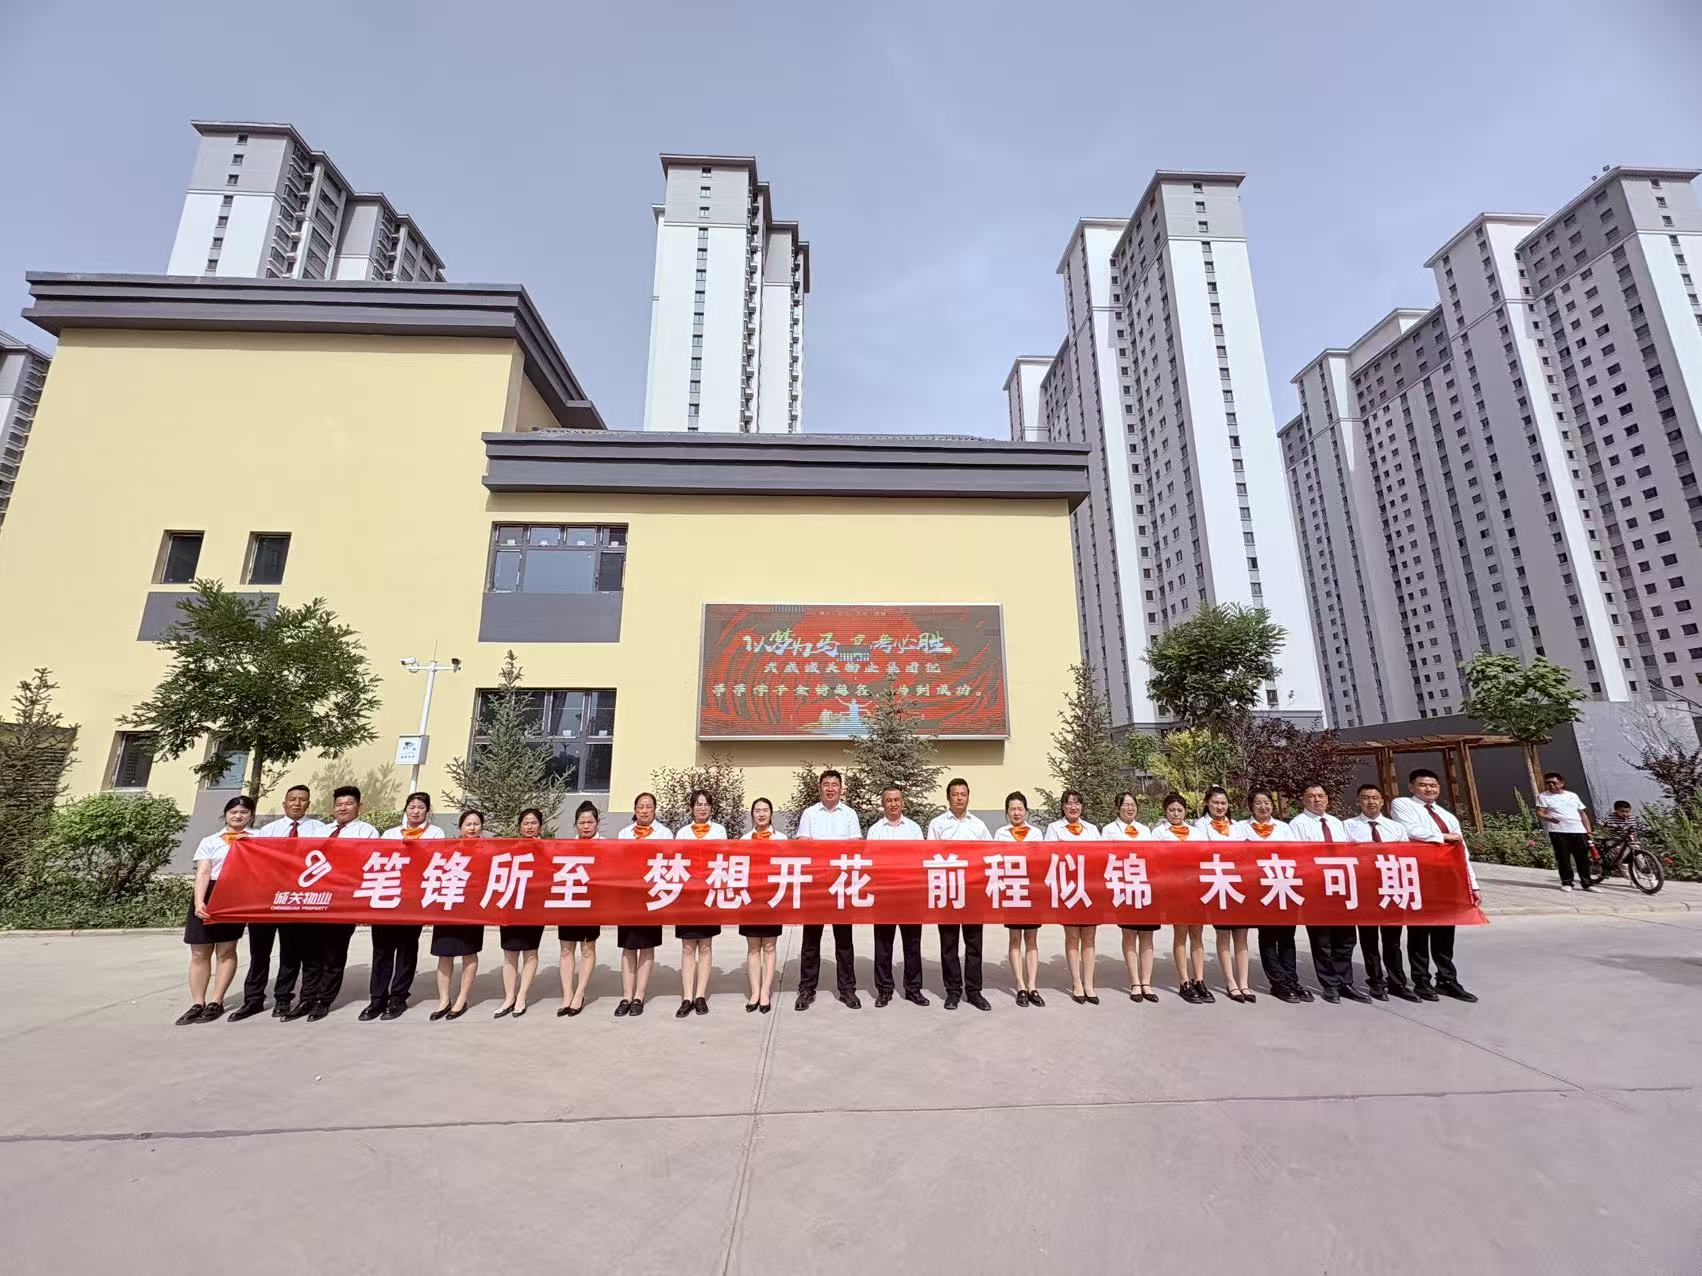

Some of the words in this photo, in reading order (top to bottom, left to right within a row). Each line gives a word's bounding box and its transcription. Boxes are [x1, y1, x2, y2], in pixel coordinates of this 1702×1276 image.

[273, 890, 333, 905] 城关物业
[353, 851, 596, 911] 笔锋所至
[643, 852, 876, 911] 梦想开花
[922, 852, 1153, 910] 前程似锦
[1198, 853, 1424, 911] 未来可期
